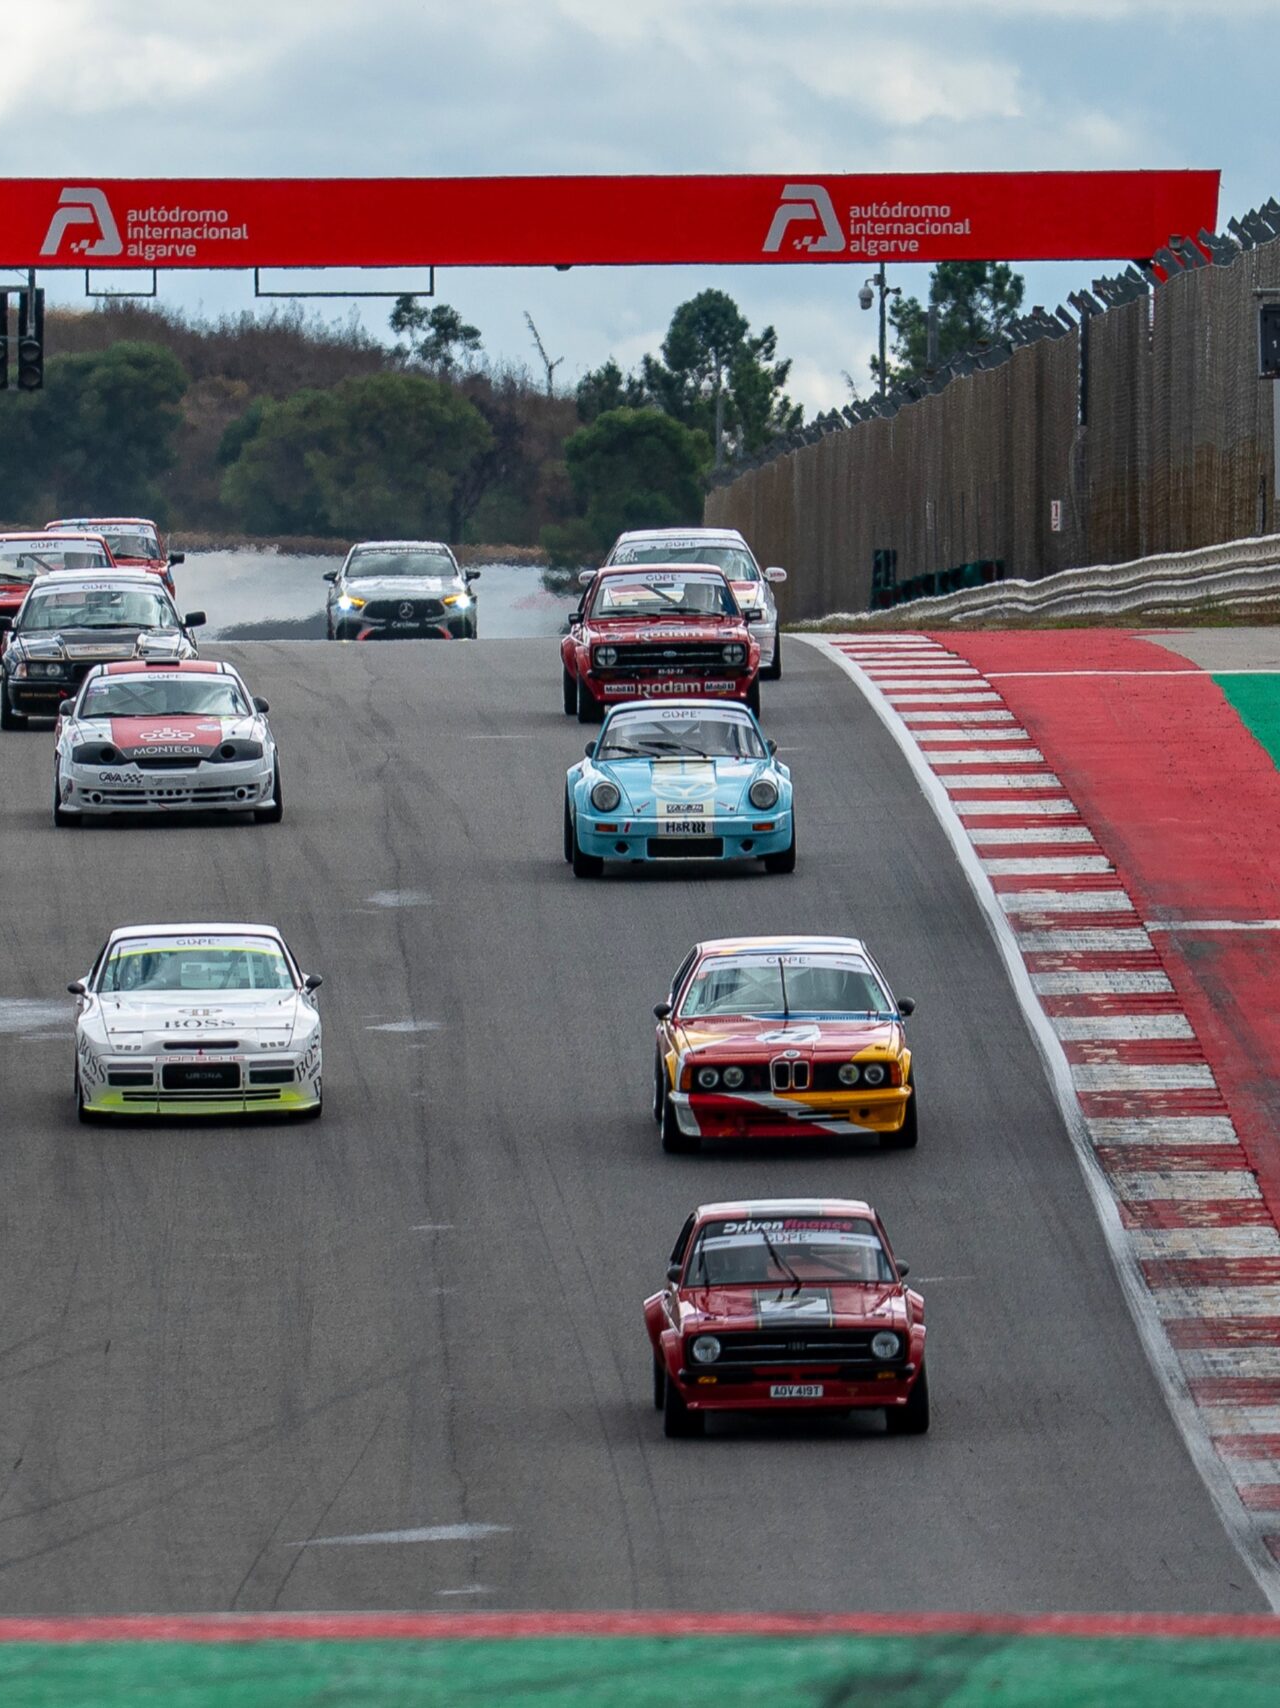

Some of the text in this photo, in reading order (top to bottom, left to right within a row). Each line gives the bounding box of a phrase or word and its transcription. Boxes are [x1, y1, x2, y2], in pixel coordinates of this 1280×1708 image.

[126, 206, 229, 223] autódromo
[849, 202, 951, 218] autódromo
[126, 223, 249, 240] internacional
[849, 218, 972, 235] internacional
[126, 241, 197, 261] algarve
[849, 237, 919, 256] algarve
[637, 680, 701, 698] Rodam
[133, 745, 203, 756] MONTEGIL
[99, 771, 123, 782] CAVA
[665, 821, 690, 833] H&R
[165, 1019, 236, 1029] BOSS
[795, 1385, 820, 1396] 419T
